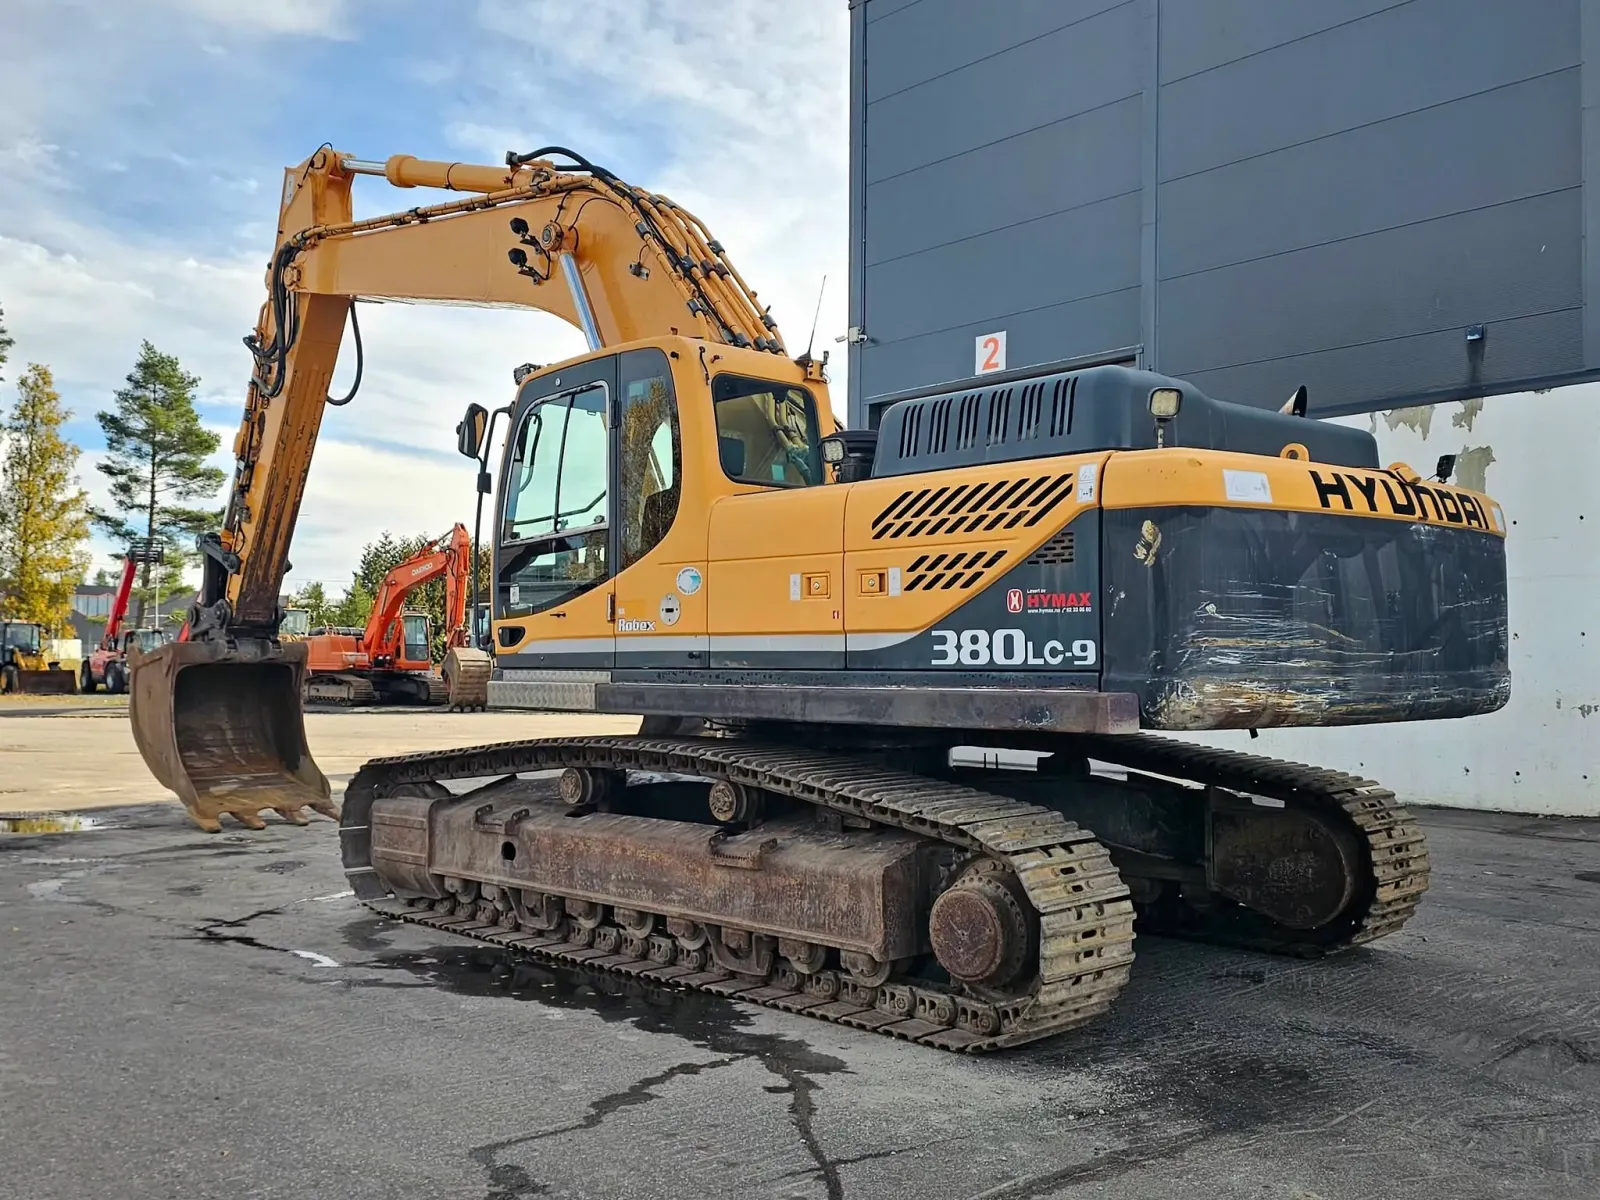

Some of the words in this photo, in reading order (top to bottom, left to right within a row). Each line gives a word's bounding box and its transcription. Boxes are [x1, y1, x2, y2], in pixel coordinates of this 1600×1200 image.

[983, 337, 999, 370] 2
[1308, 470, 1489, 530] HYUNDAI
[1027, 593, 1092, 607] HYMAX
[618, 618, 656, 632] Robex
